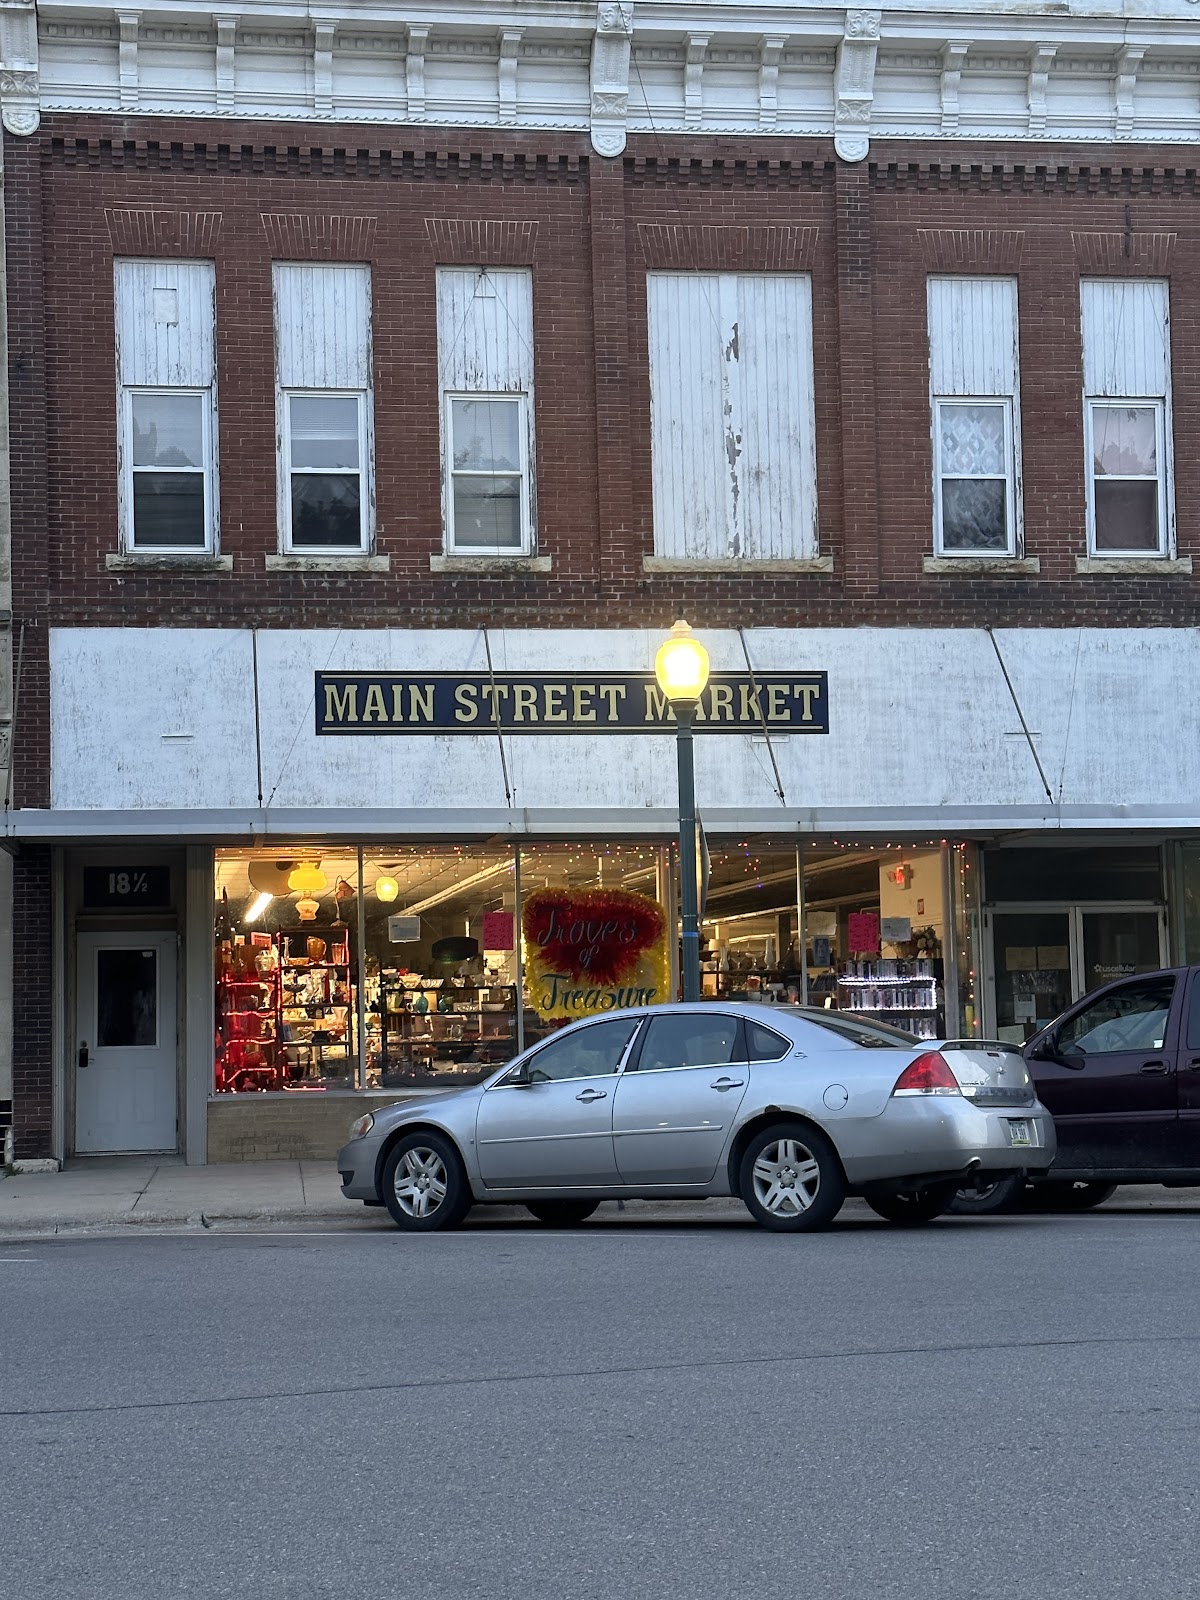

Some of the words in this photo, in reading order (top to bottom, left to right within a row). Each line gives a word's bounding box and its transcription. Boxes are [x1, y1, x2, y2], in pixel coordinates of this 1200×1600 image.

[323, 684, 436, 722] MAIN
[454, 684, 627, 722] STREET
[535, 902, 639, 945] Troves
[578, 944, 600, 969] of
[539, 973, 657, 1011] Treasure
